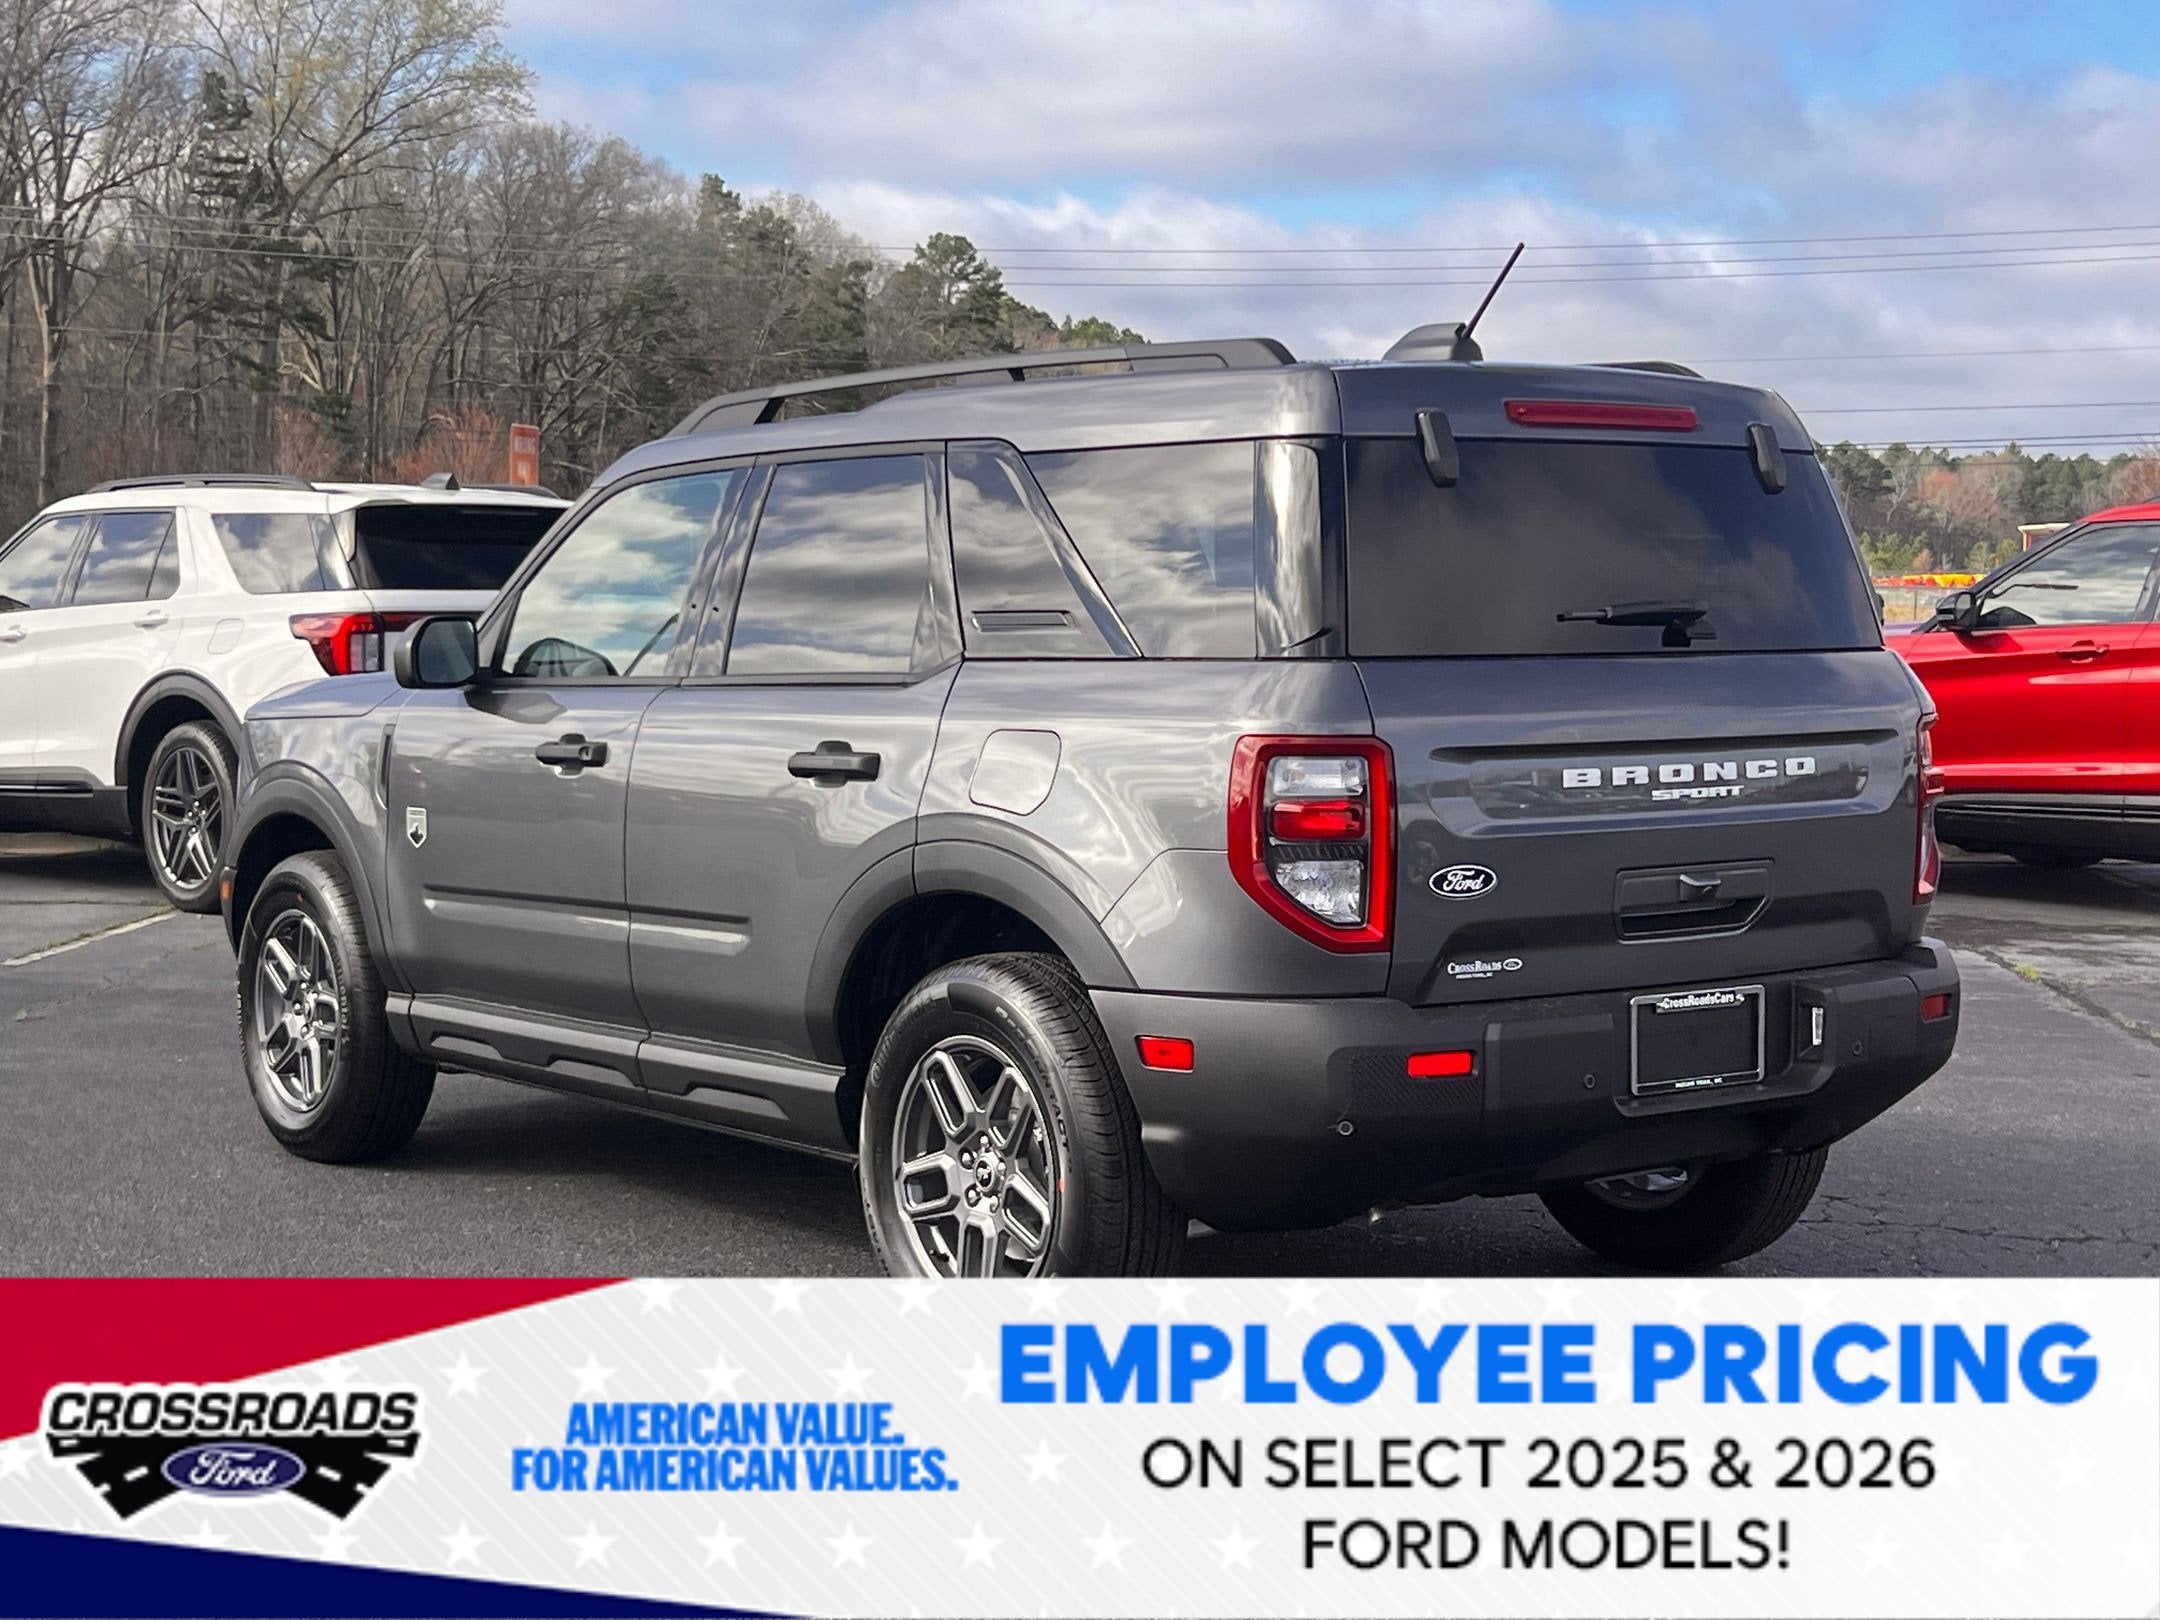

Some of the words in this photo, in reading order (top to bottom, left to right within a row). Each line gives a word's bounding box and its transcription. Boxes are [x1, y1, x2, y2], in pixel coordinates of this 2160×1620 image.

[1562, 757, 1816, 788] BRONCO
[1651, 785, 1744, 800] SPORT
[1442, 869, 1486, 892] Ford
